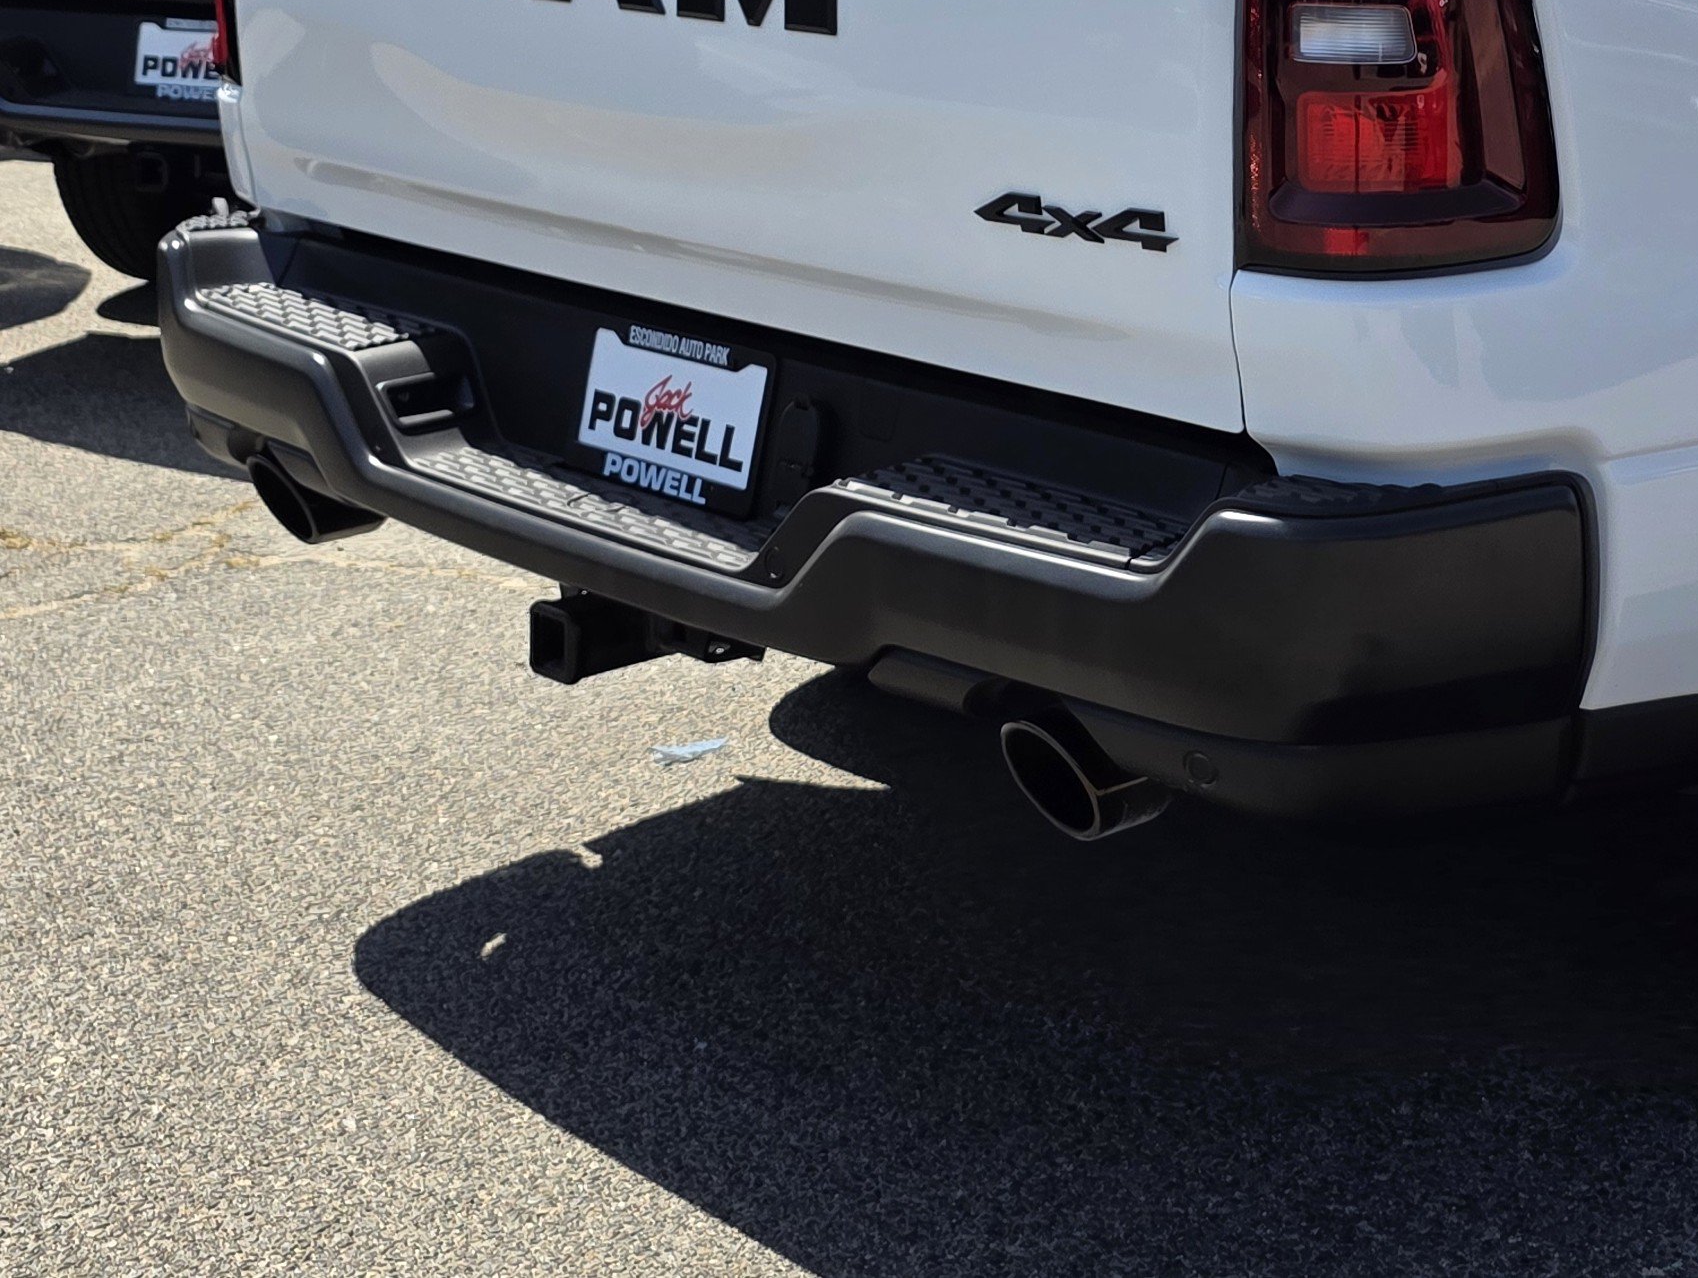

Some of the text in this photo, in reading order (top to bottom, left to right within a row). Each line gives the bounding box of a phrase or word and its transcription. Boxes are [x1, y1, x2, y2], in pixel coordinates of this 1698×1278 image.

[142, 54, 219, 80] POWE
[156, 84, 217, 101] POWE
[629, 325, 730, 366] ESCONDIDO AUTO PARK
[640, 374, 693, 428] Jack
[588, 389, 743, 473] POWELL
[603, 452, 706, 505] POWELL
